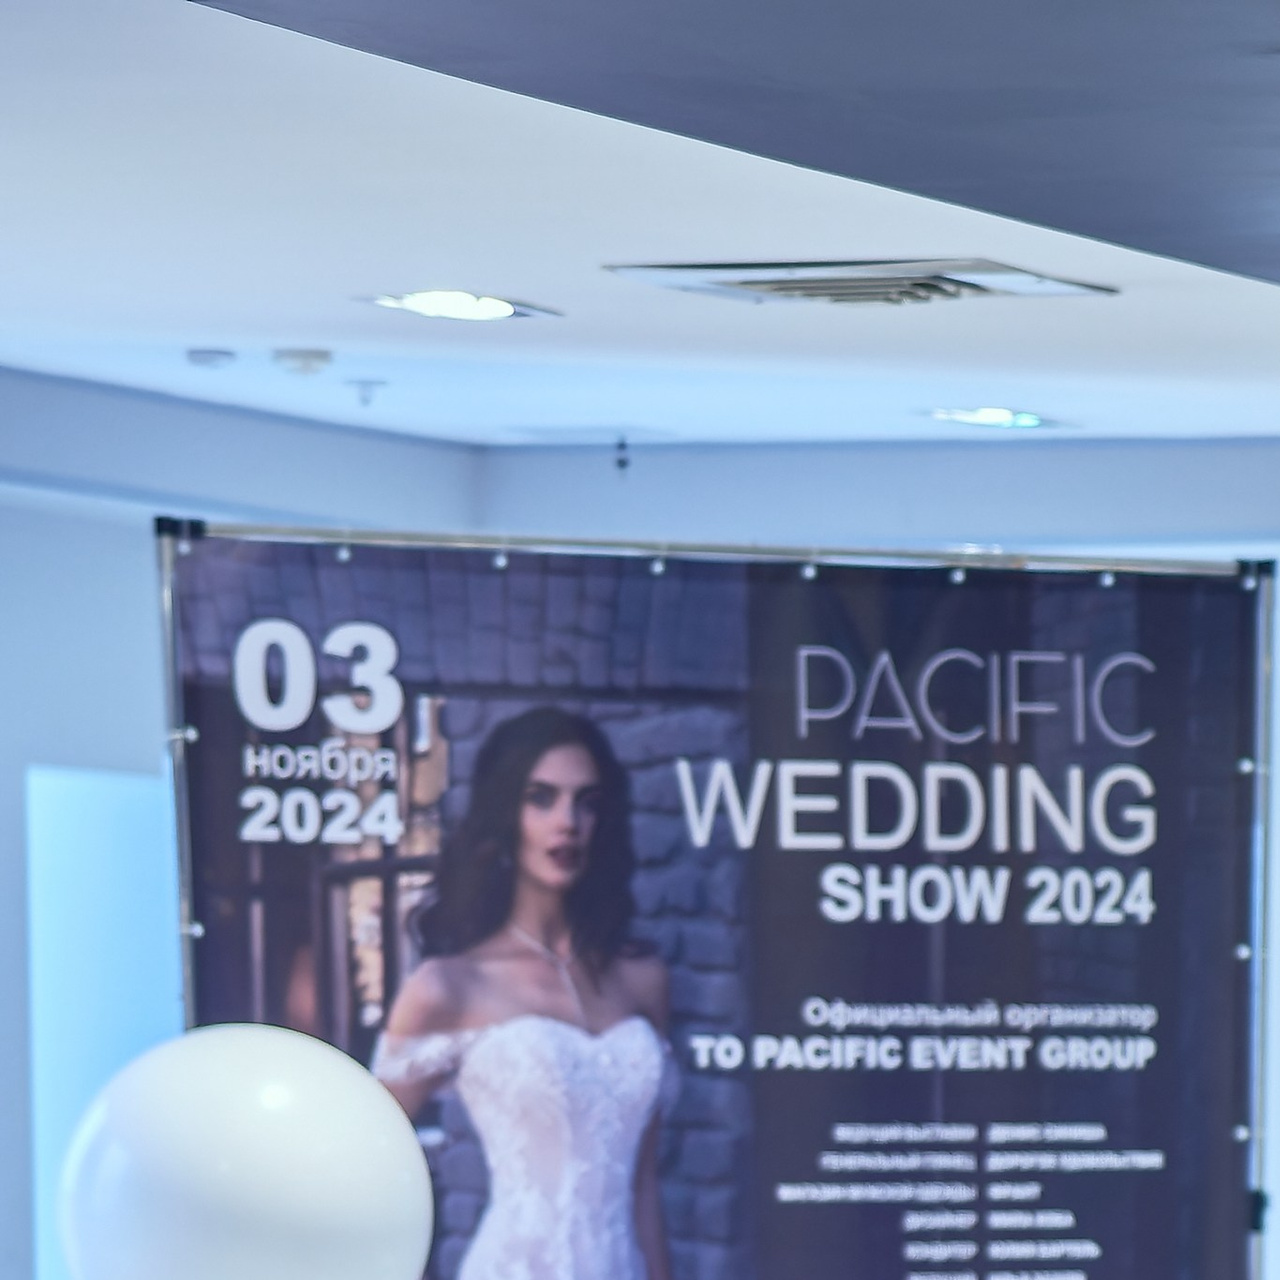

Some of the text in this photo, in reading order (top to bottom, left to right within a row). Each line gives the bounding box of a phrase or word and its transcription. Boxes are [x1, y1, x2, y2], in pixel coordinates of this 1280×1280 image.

[232, 618, 405, 736] 03
[796, 645, 1157, 747] PACIFIC
[243, 738, 399, 788] ноября
[239, 788, 405, 846] 2024
[675, 758, 1157, 854] WEDDING
[820, 863, 1156, 925] SHOW 2024
[802, 997, 1158, 1031] Официальный организатор
[752, 1035, 903, 1070] PACIFIC
[909, 1037, 1032, 1070] EVENT
[1038, 1037, 1157, 1070] GROUP
